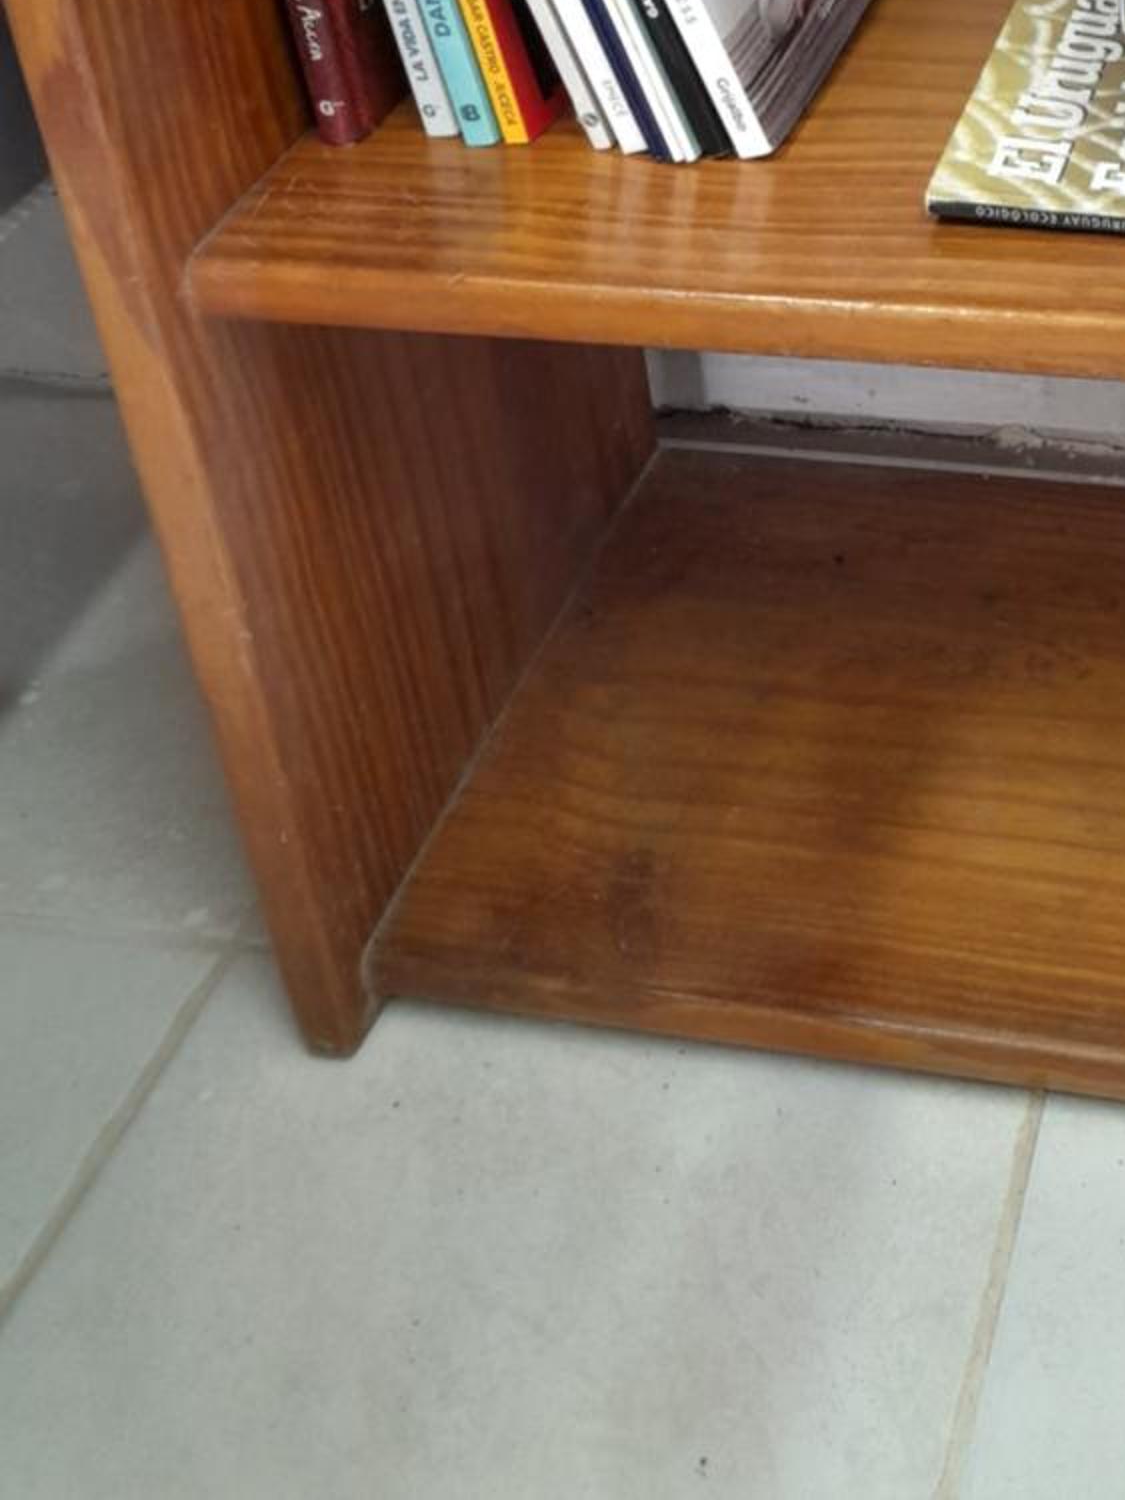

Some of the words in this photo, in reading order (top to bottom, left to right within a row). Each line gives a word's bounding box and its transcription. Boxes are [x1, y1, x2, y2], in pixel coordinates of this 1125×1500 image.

[298, 3, 325, 62] Accra
[402, 19, 425, 61] VIDA
[414, 66, 429, 82] LA
[715, 76, 748, 134] Grijalbo
[984, 132, 1075, 184] El
